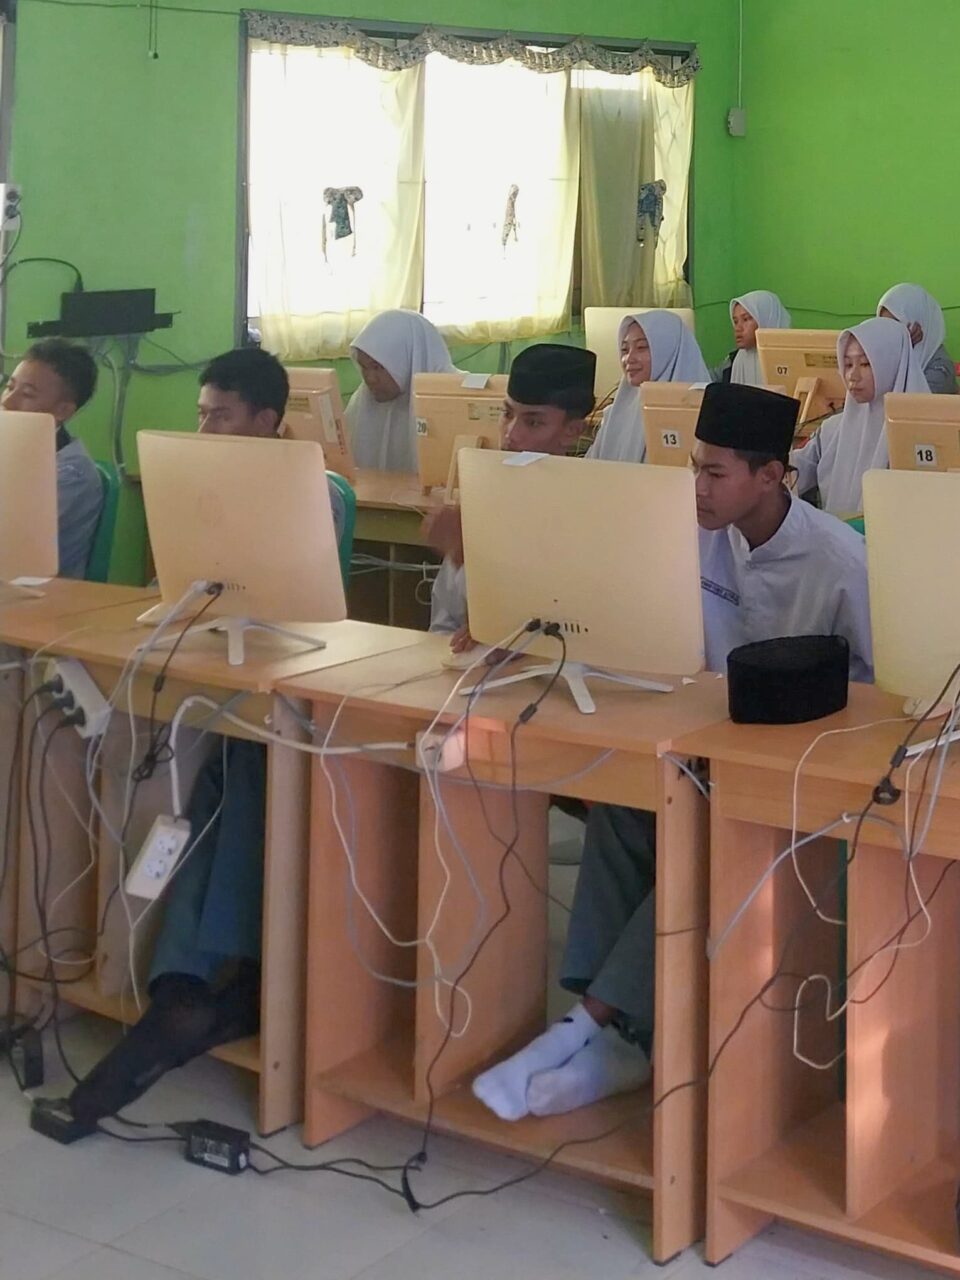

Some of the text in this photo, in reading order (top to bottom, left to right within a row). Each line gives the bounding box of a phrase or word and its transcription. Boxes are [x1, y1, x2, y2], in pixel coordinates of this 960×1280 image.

[776, 366, 788, 375] 07
[417, 421, 427, 433] 20
[663, 433, 677, 445] 13
[916, 449, 934, 462] 18
